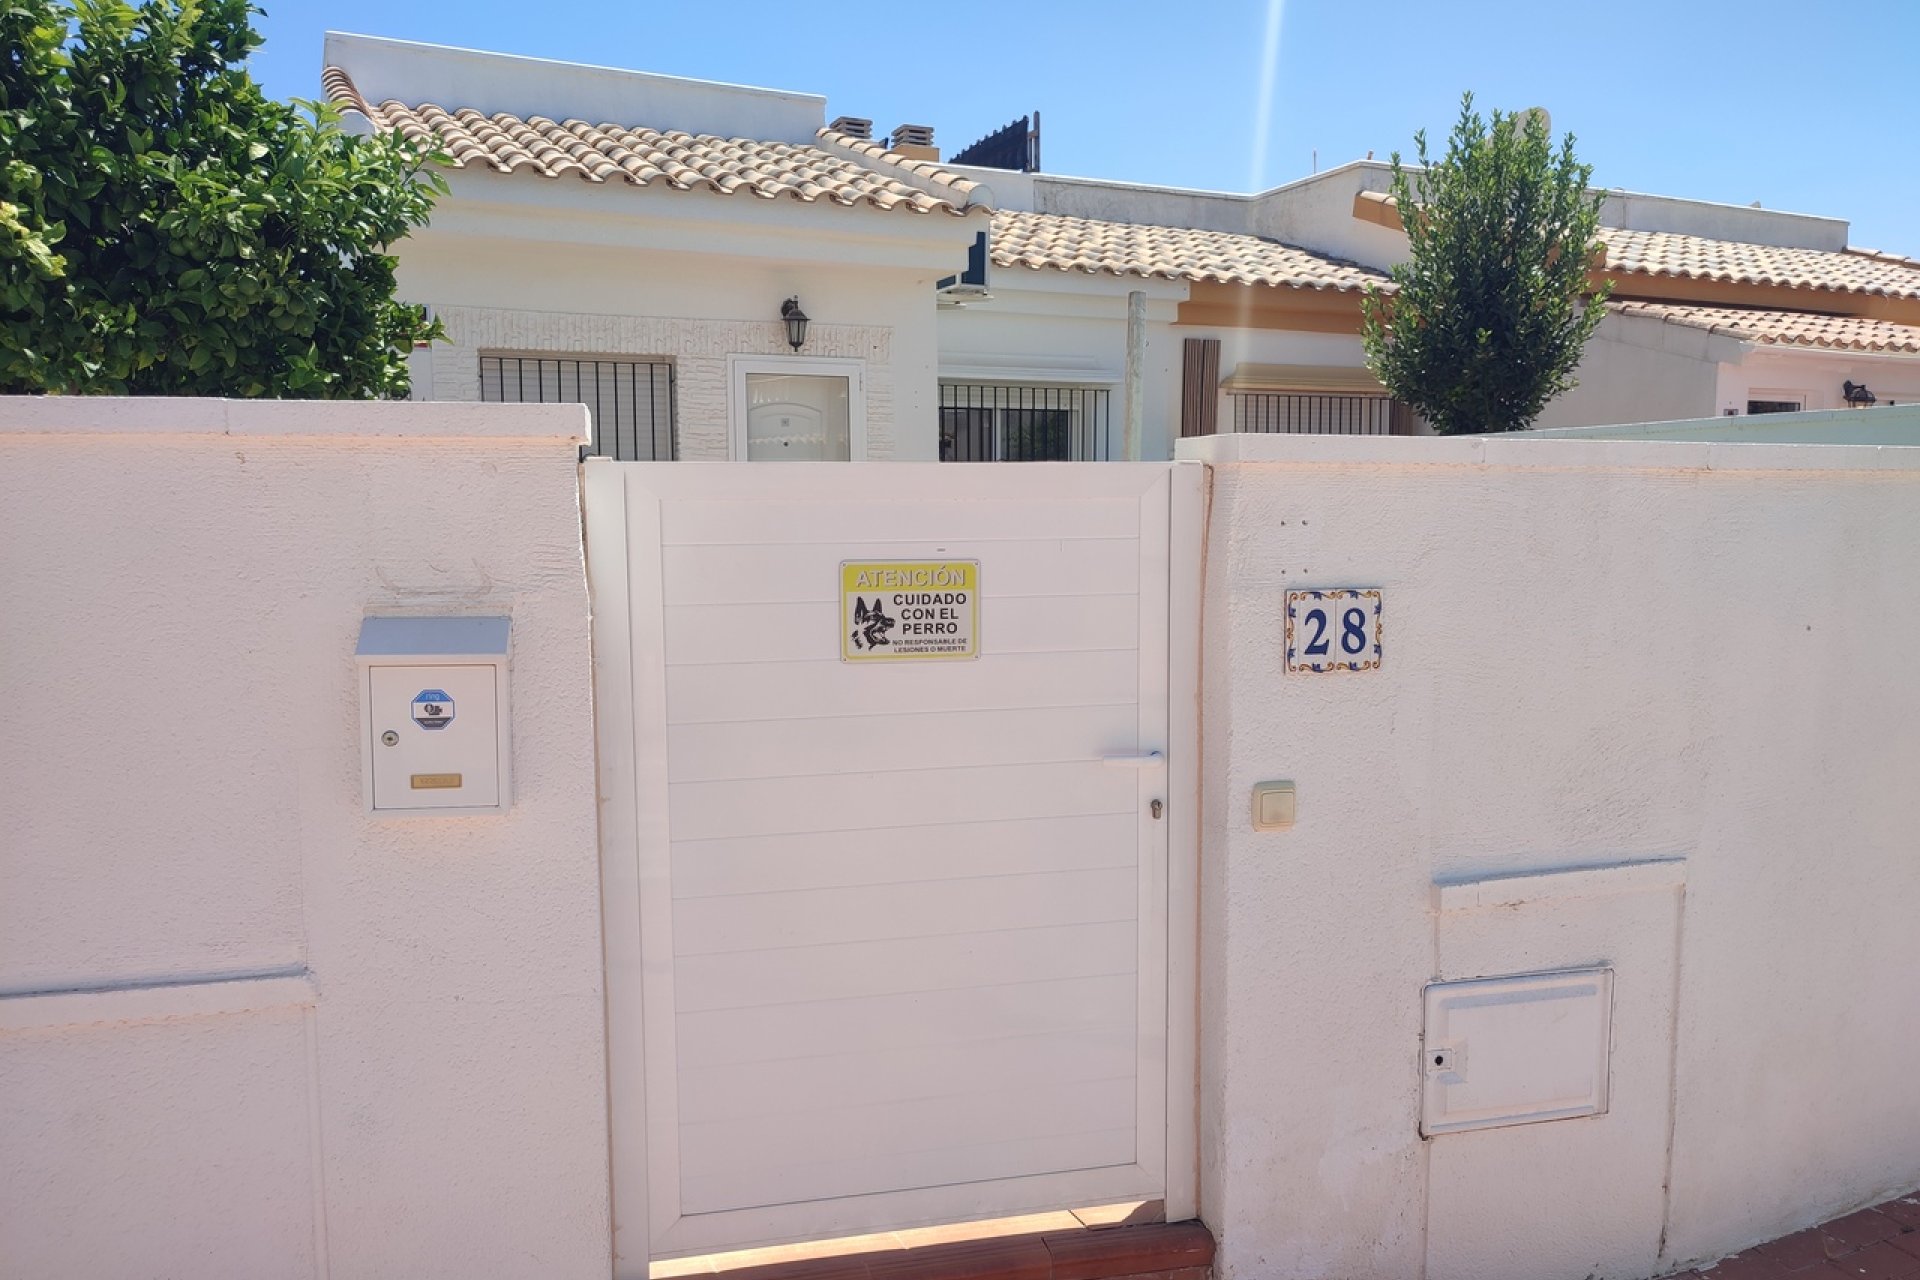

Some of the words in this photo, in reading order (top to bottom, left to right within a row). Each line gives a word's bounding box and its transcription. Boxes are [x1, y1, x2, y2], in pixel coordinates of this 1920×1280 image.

[856, 565, 966, 588] ATENCIÓN
[893, 593, 967, 606] CUIDADO
[901, 608, 935, 620] CON
[940, 607, 959, 620] EL
[902, 622, 958, 635] PERRO
[1304, 607, 1366, 655] 28
[904, 638, 956, 646] RESPONSABLE
[957, 637, 967, 645] DE
[937, 645, 966, 653] MUERTE
